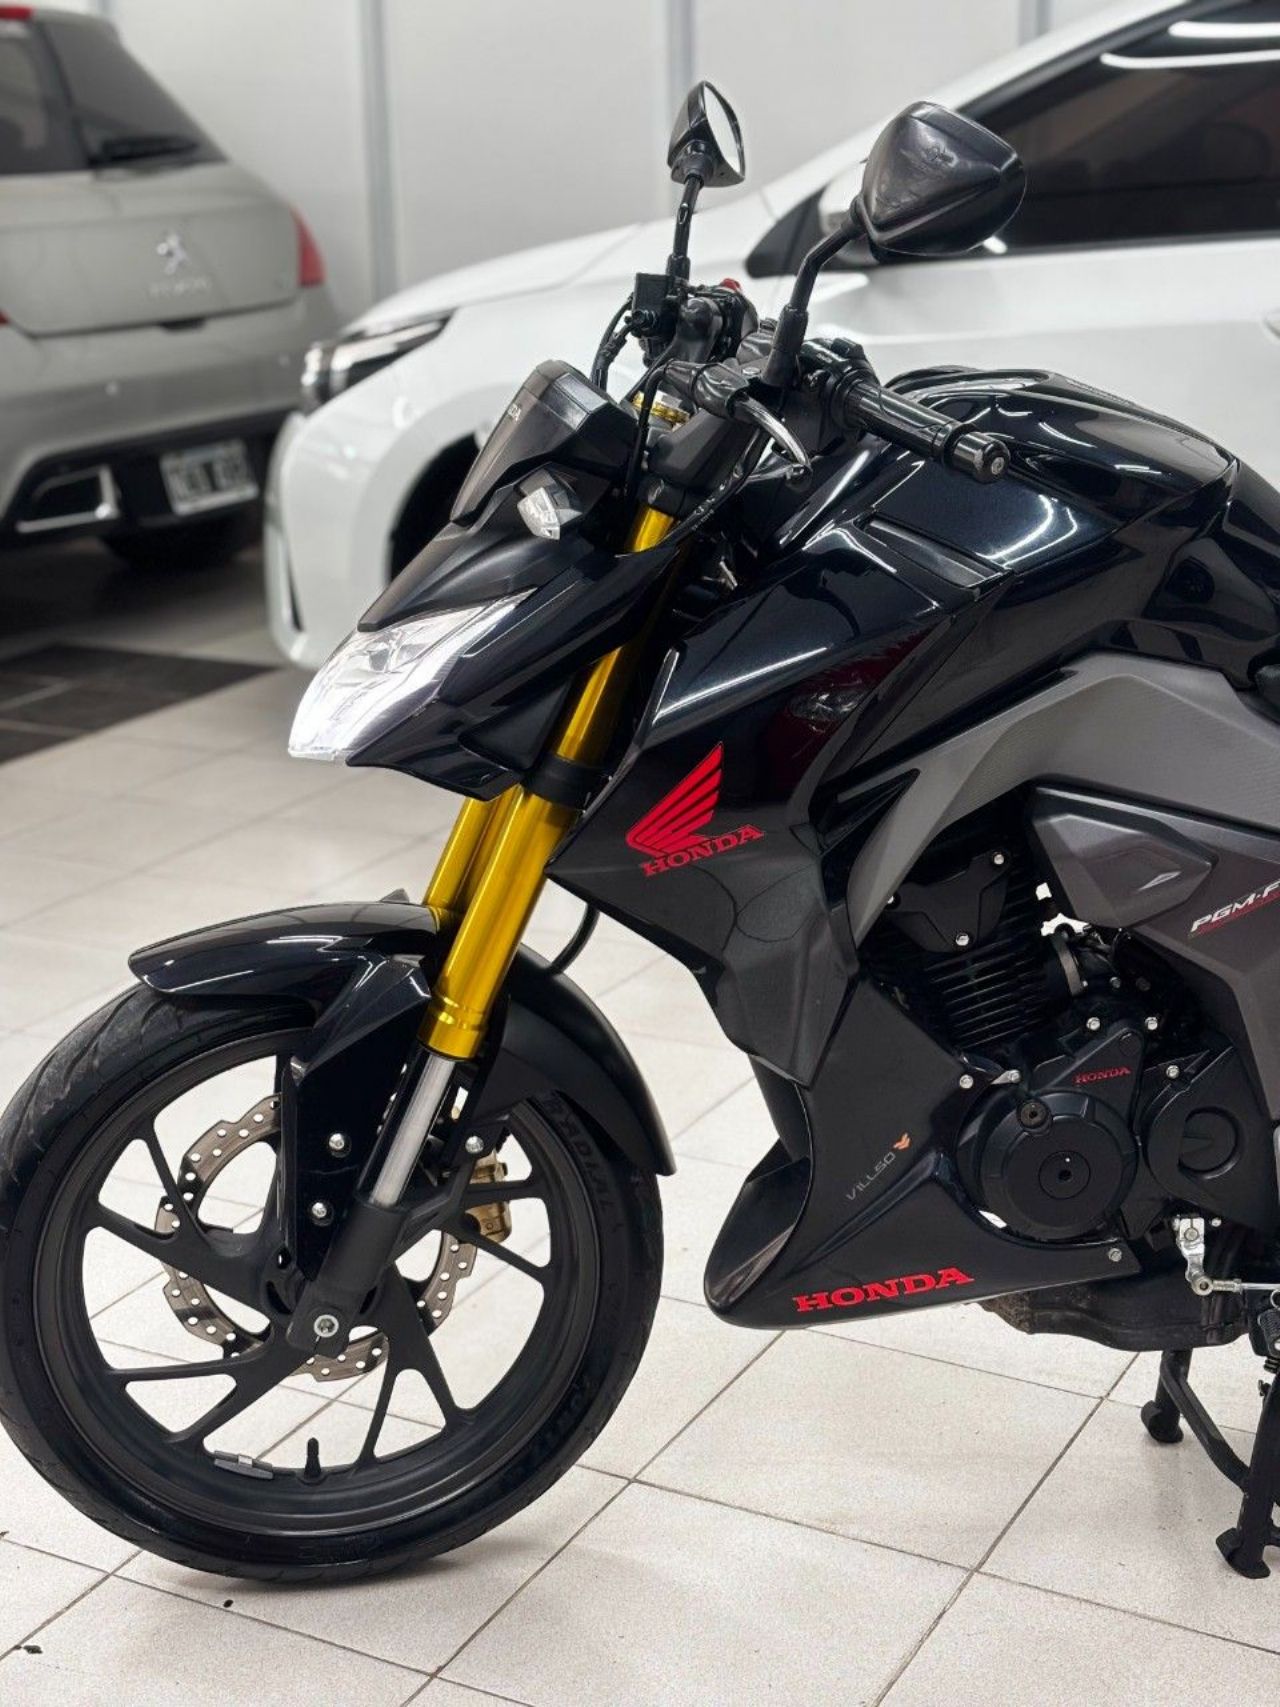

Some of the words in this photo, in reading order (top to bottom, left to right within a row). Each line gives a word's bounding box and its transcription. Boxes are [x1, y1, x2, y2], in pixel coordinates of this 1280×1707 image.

[640, 824, 765, 877] HONDA
[1074, 1067, 1132, 1086] HONDA
[793, 1267, 976, 1312] HONDA
